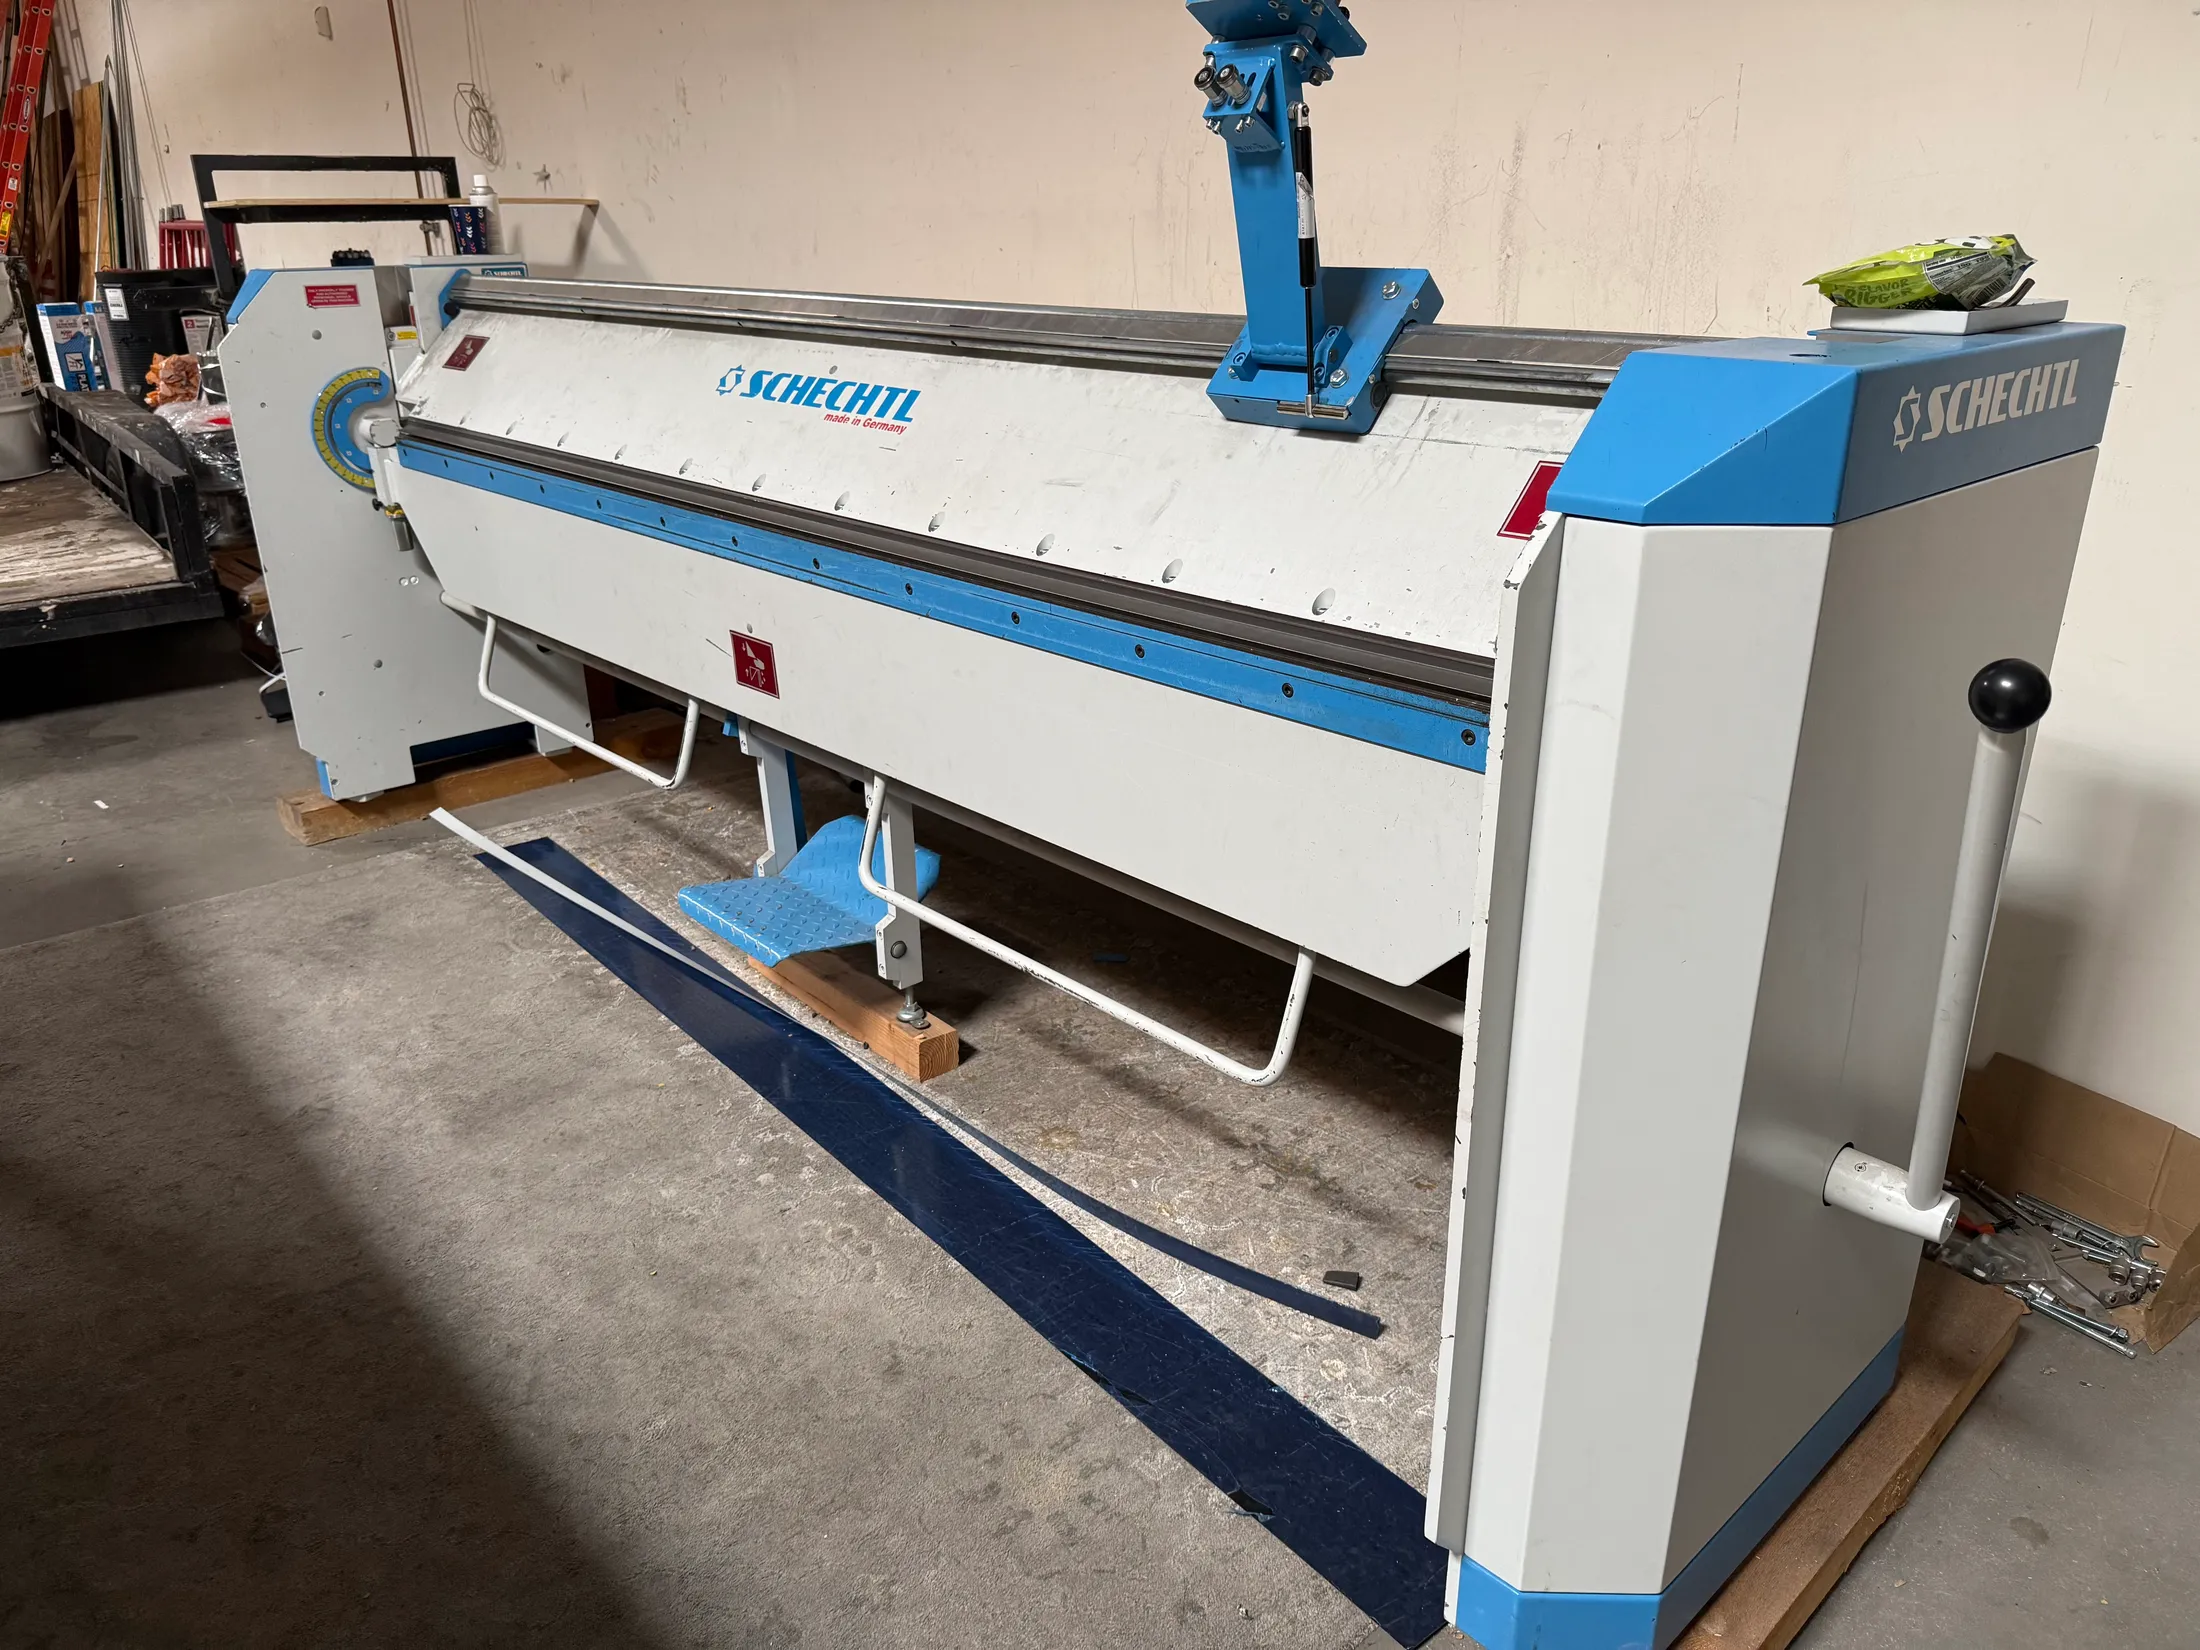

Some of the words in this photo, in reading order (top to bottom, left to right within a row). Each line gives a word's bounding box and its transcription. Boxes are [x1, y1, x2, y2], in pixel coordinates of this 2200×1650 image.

[1845, 286, 1915, 305] BIGGER
[739, 370, 922, 422] SCHECHTL
[1921, 359, 2080, 441] SCHECHTL
[824, 413, 850, 424] made
[851, 416, 862, 426] in
[863, 418, 907, 435] Germany
